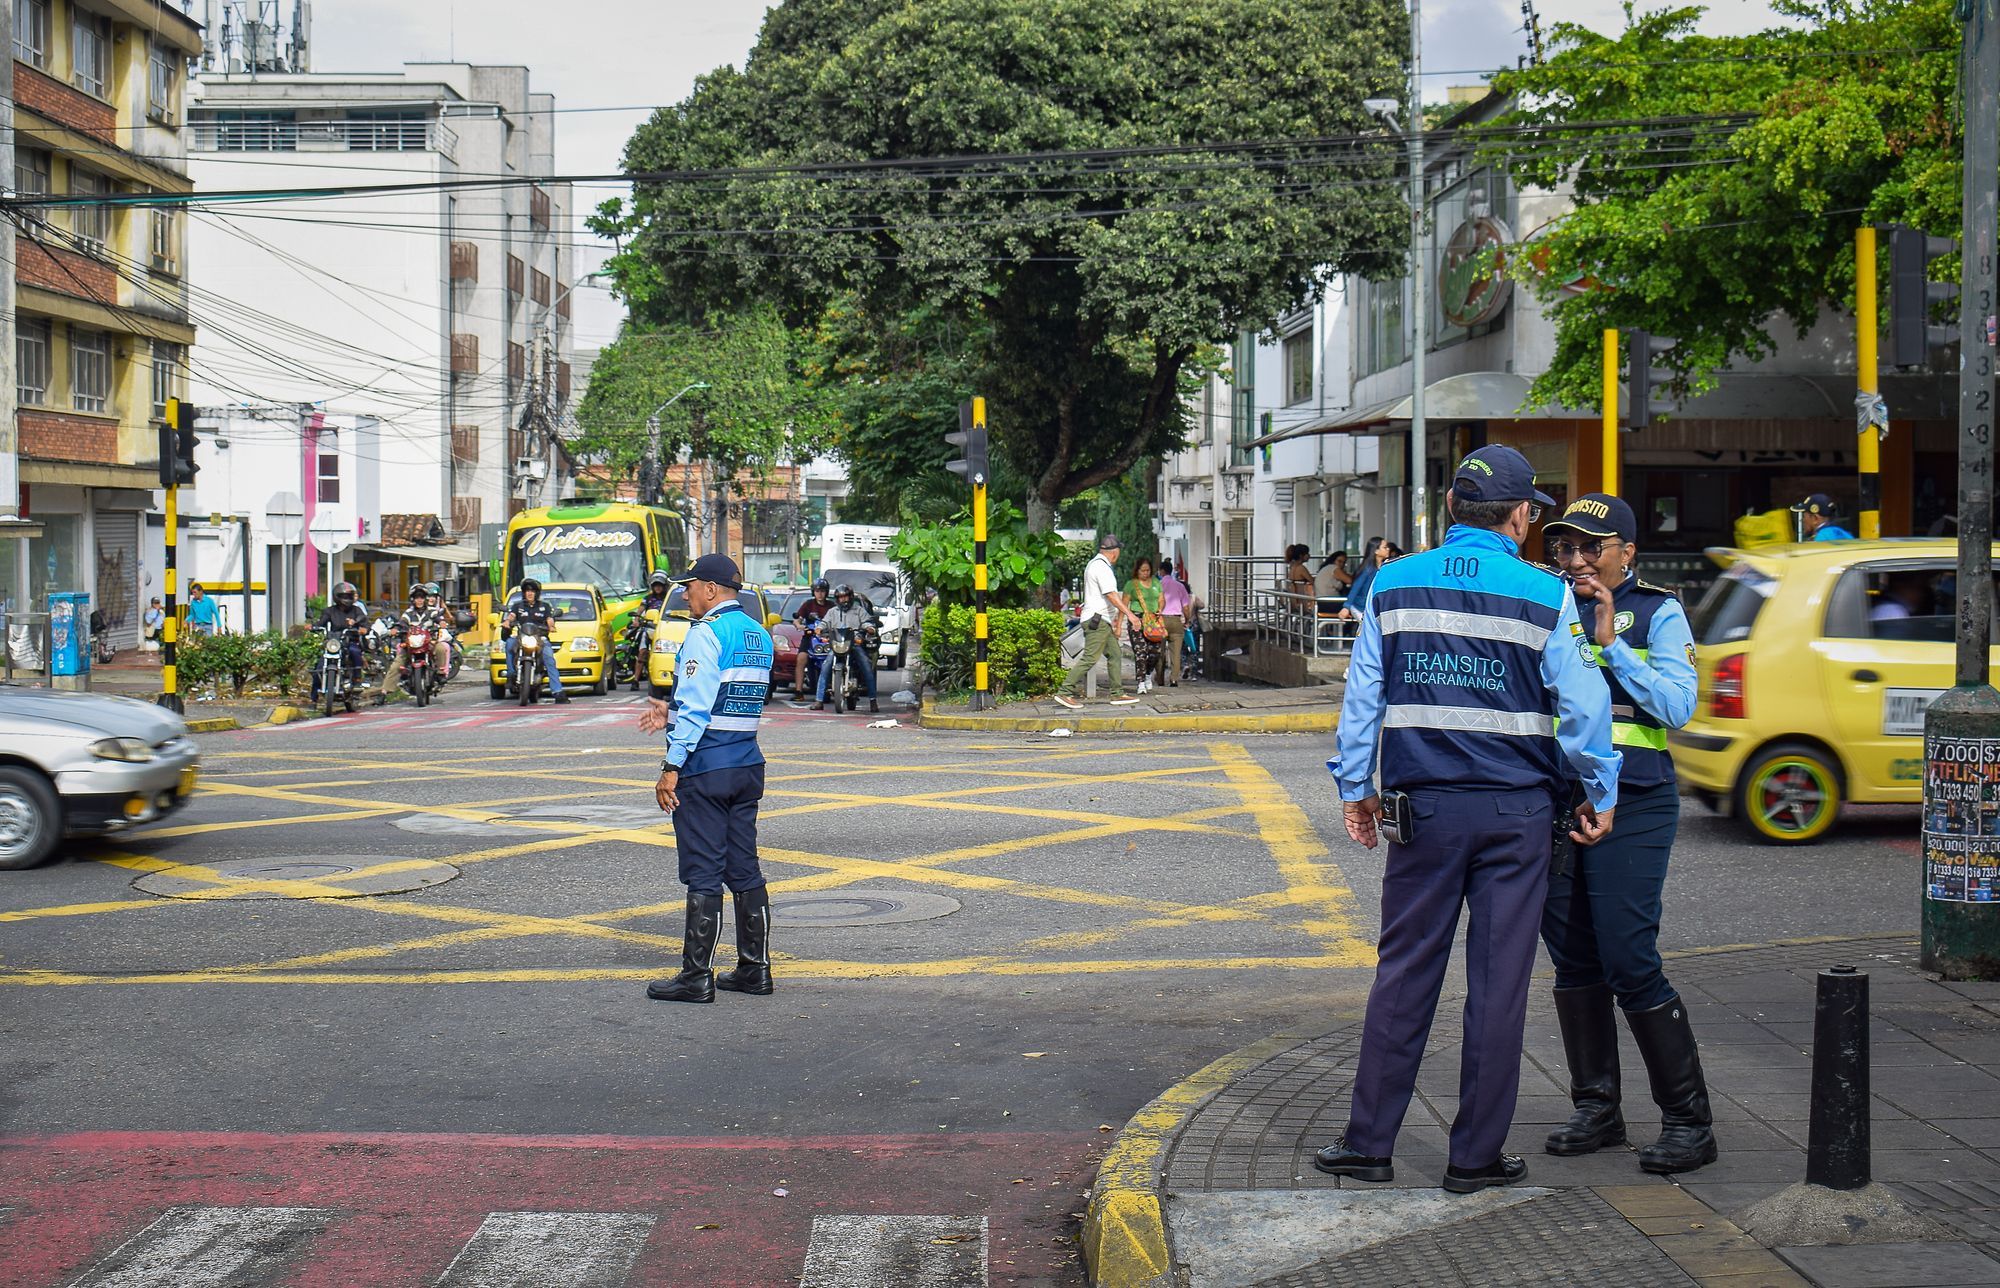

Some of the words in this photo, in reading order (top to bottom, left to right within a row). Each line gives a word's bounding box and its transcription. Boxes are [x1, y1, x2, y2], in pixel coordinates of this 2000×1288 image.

[1442, 557, 1479, 578] 100
[746, 634, 760, 650] 170
[742, 655, 767, 666] AGENTE
[1403, 652, 1506, 677] TRANSITO
[1404, 671, 1506, 692] BUCARAMANGA
[1942, 783, 1961, 800] 7333
[1963, 784, 1979, 801] 450
[1952, 866, 1965, 876] 450
[1982, 868, 1997, 878] 7333
